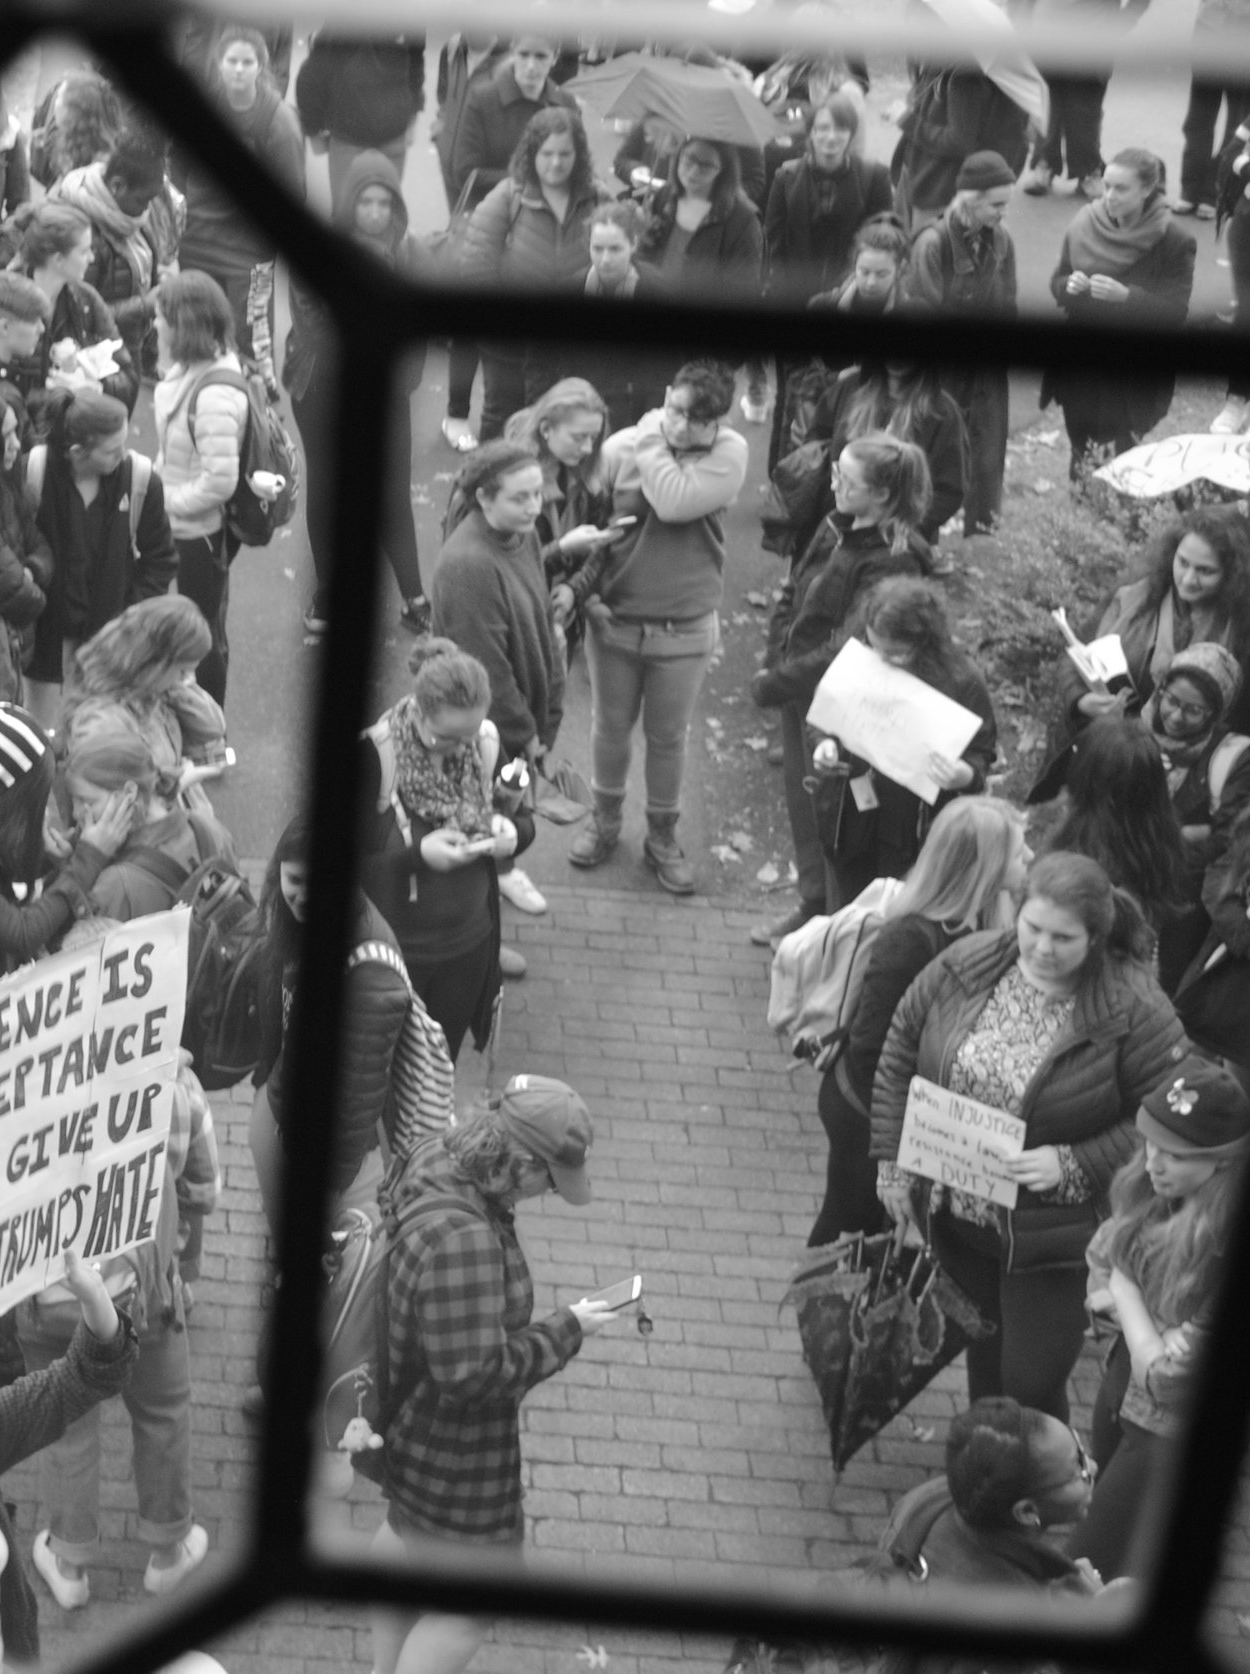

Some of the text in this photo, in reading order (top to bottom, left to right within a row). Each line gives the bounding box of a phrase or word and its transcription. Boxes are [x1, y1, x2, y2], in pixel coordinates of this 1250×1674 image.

[100, 942, 156, 1006] IS
[6, 1102, 99, 1182] GIVE
[106, 1083, 163, 1144] UP
[947, 1096, 1023, 1141] INJUSTICE
[82, 1140, 166, 1259] HATE
[940, 1162, 996, 1198] DUTY
